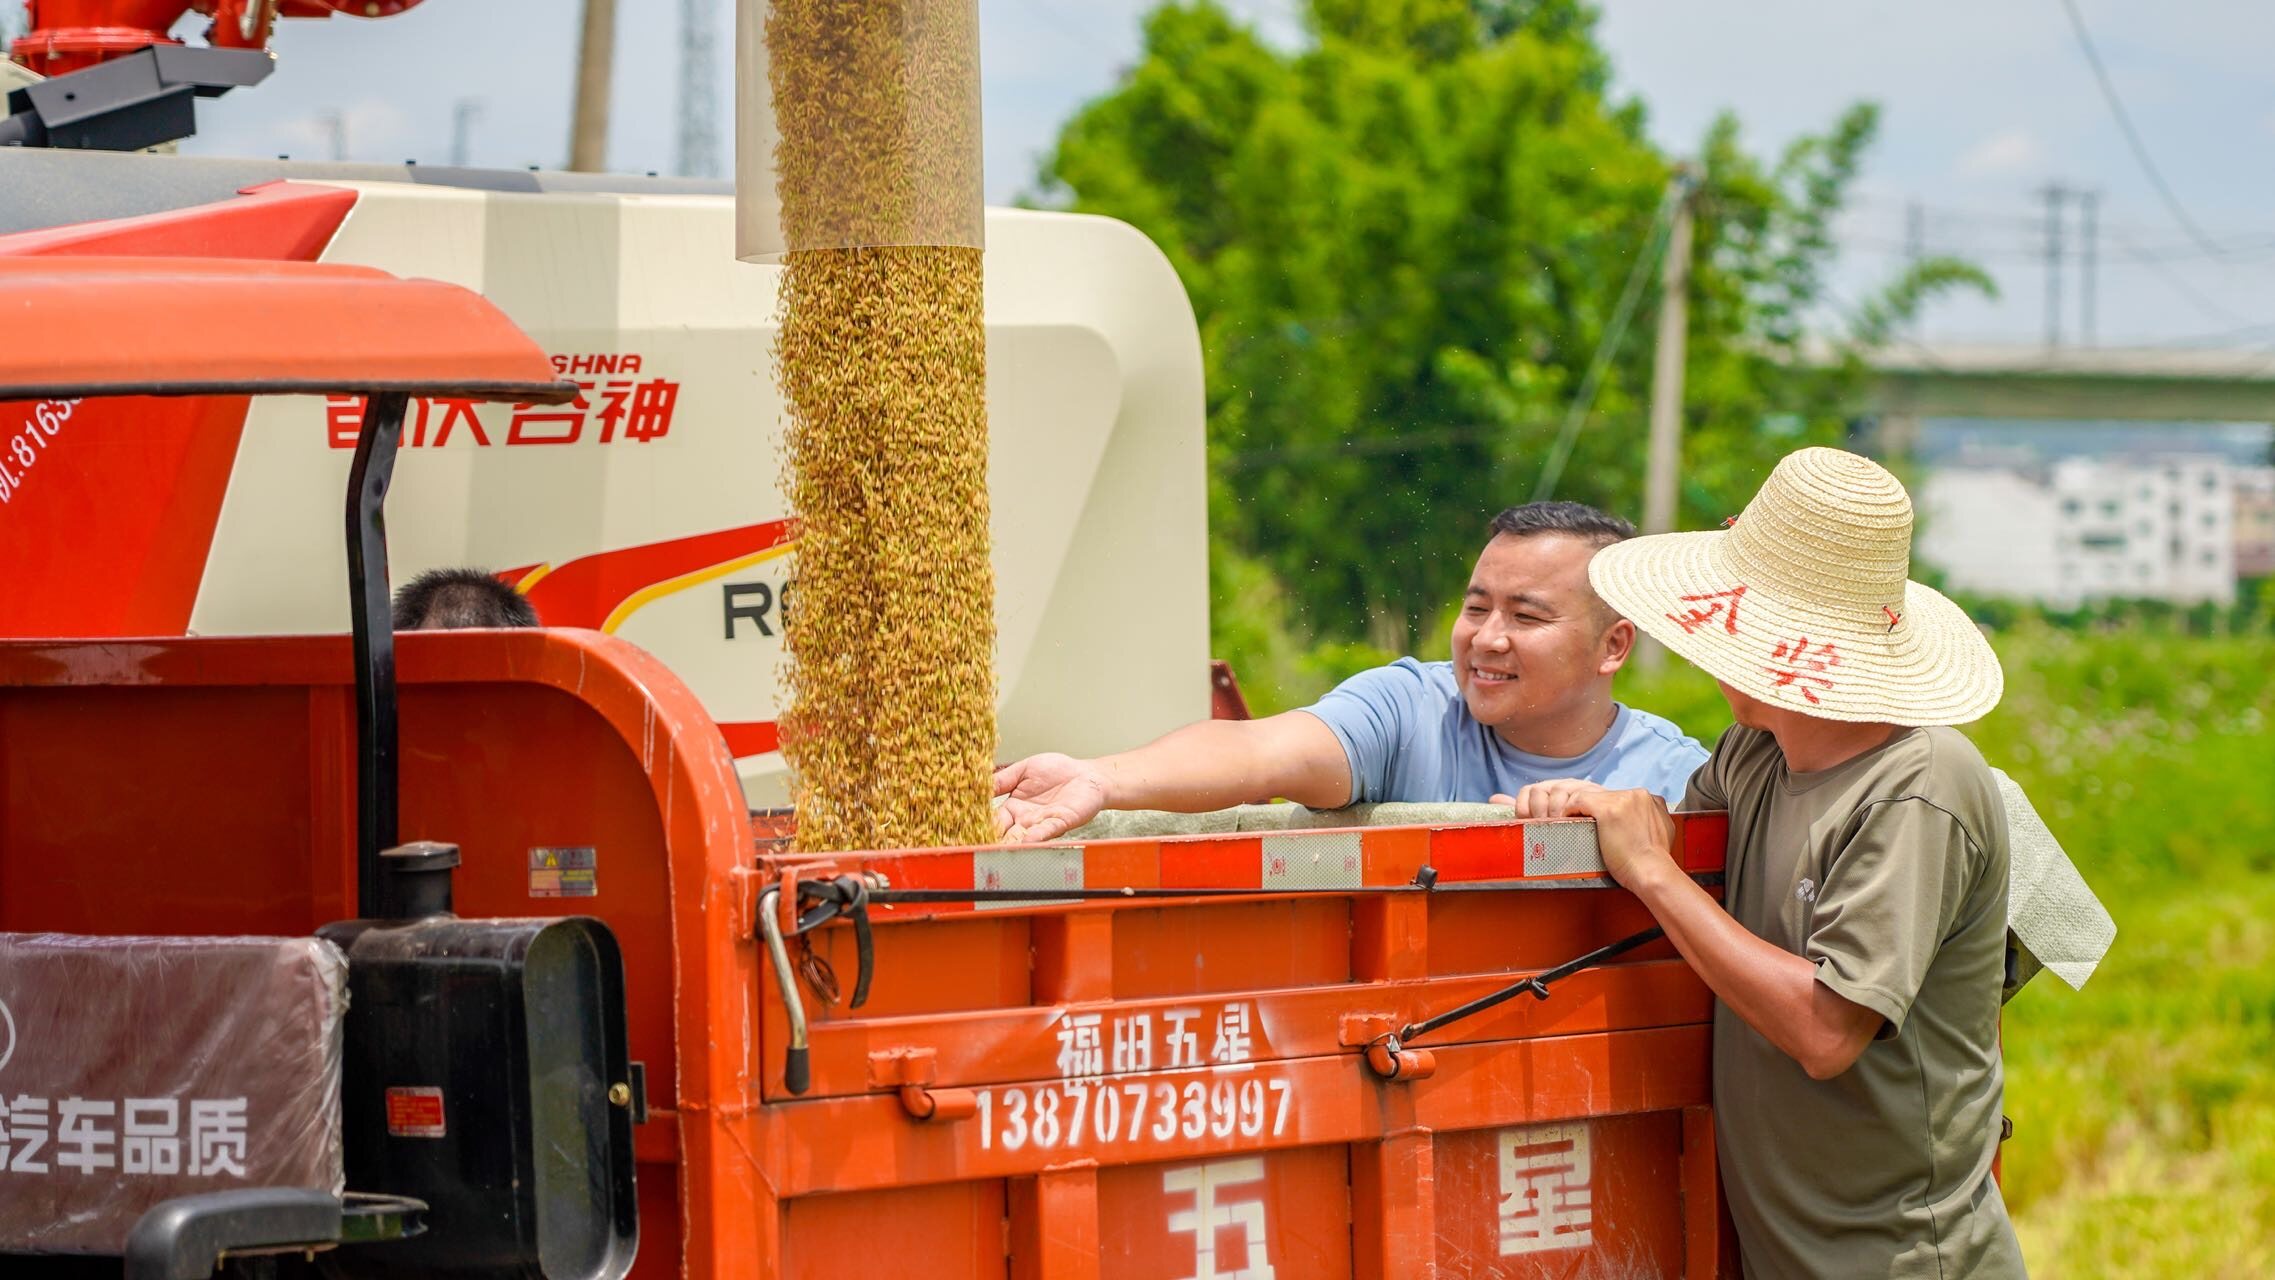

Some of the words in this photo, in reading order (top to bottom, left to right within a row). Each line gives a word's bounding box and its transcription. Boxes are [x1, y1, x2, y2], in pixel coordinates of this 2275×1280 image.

[1056, 1003, 1255, 1090] 福田五星
[0, 1093, 248, 1176] 汽车品质
[976, 1079, 1293, 1151] 13870733997
[1499, 1122, 1593, 1256] 星
